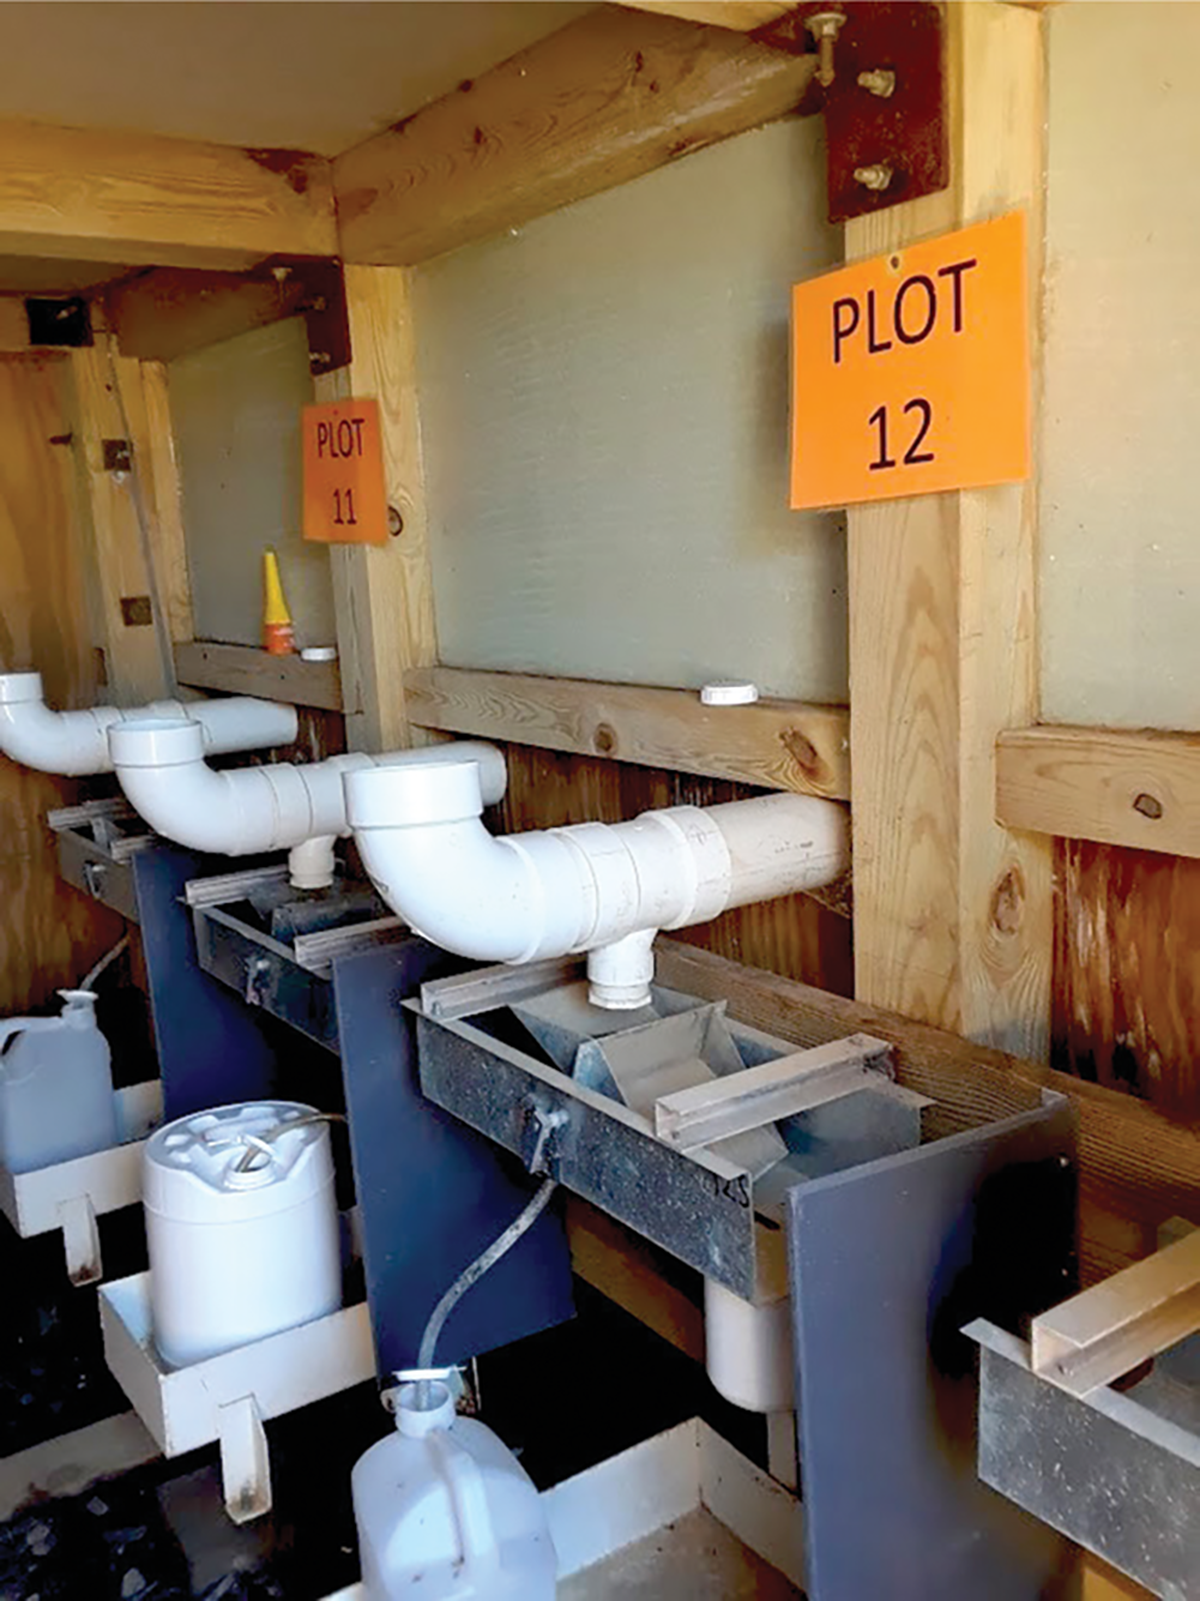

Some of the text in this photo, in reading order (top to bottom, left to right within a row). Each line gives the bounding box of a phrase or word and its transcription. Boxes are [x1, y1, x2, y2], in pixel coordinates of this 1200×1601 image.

[833, 259, 977, 363] PLOT
[317, 418, 365, 458] PLOT
[868, 398, 934, 470] 12
[333, 488, 357, 525] 11
